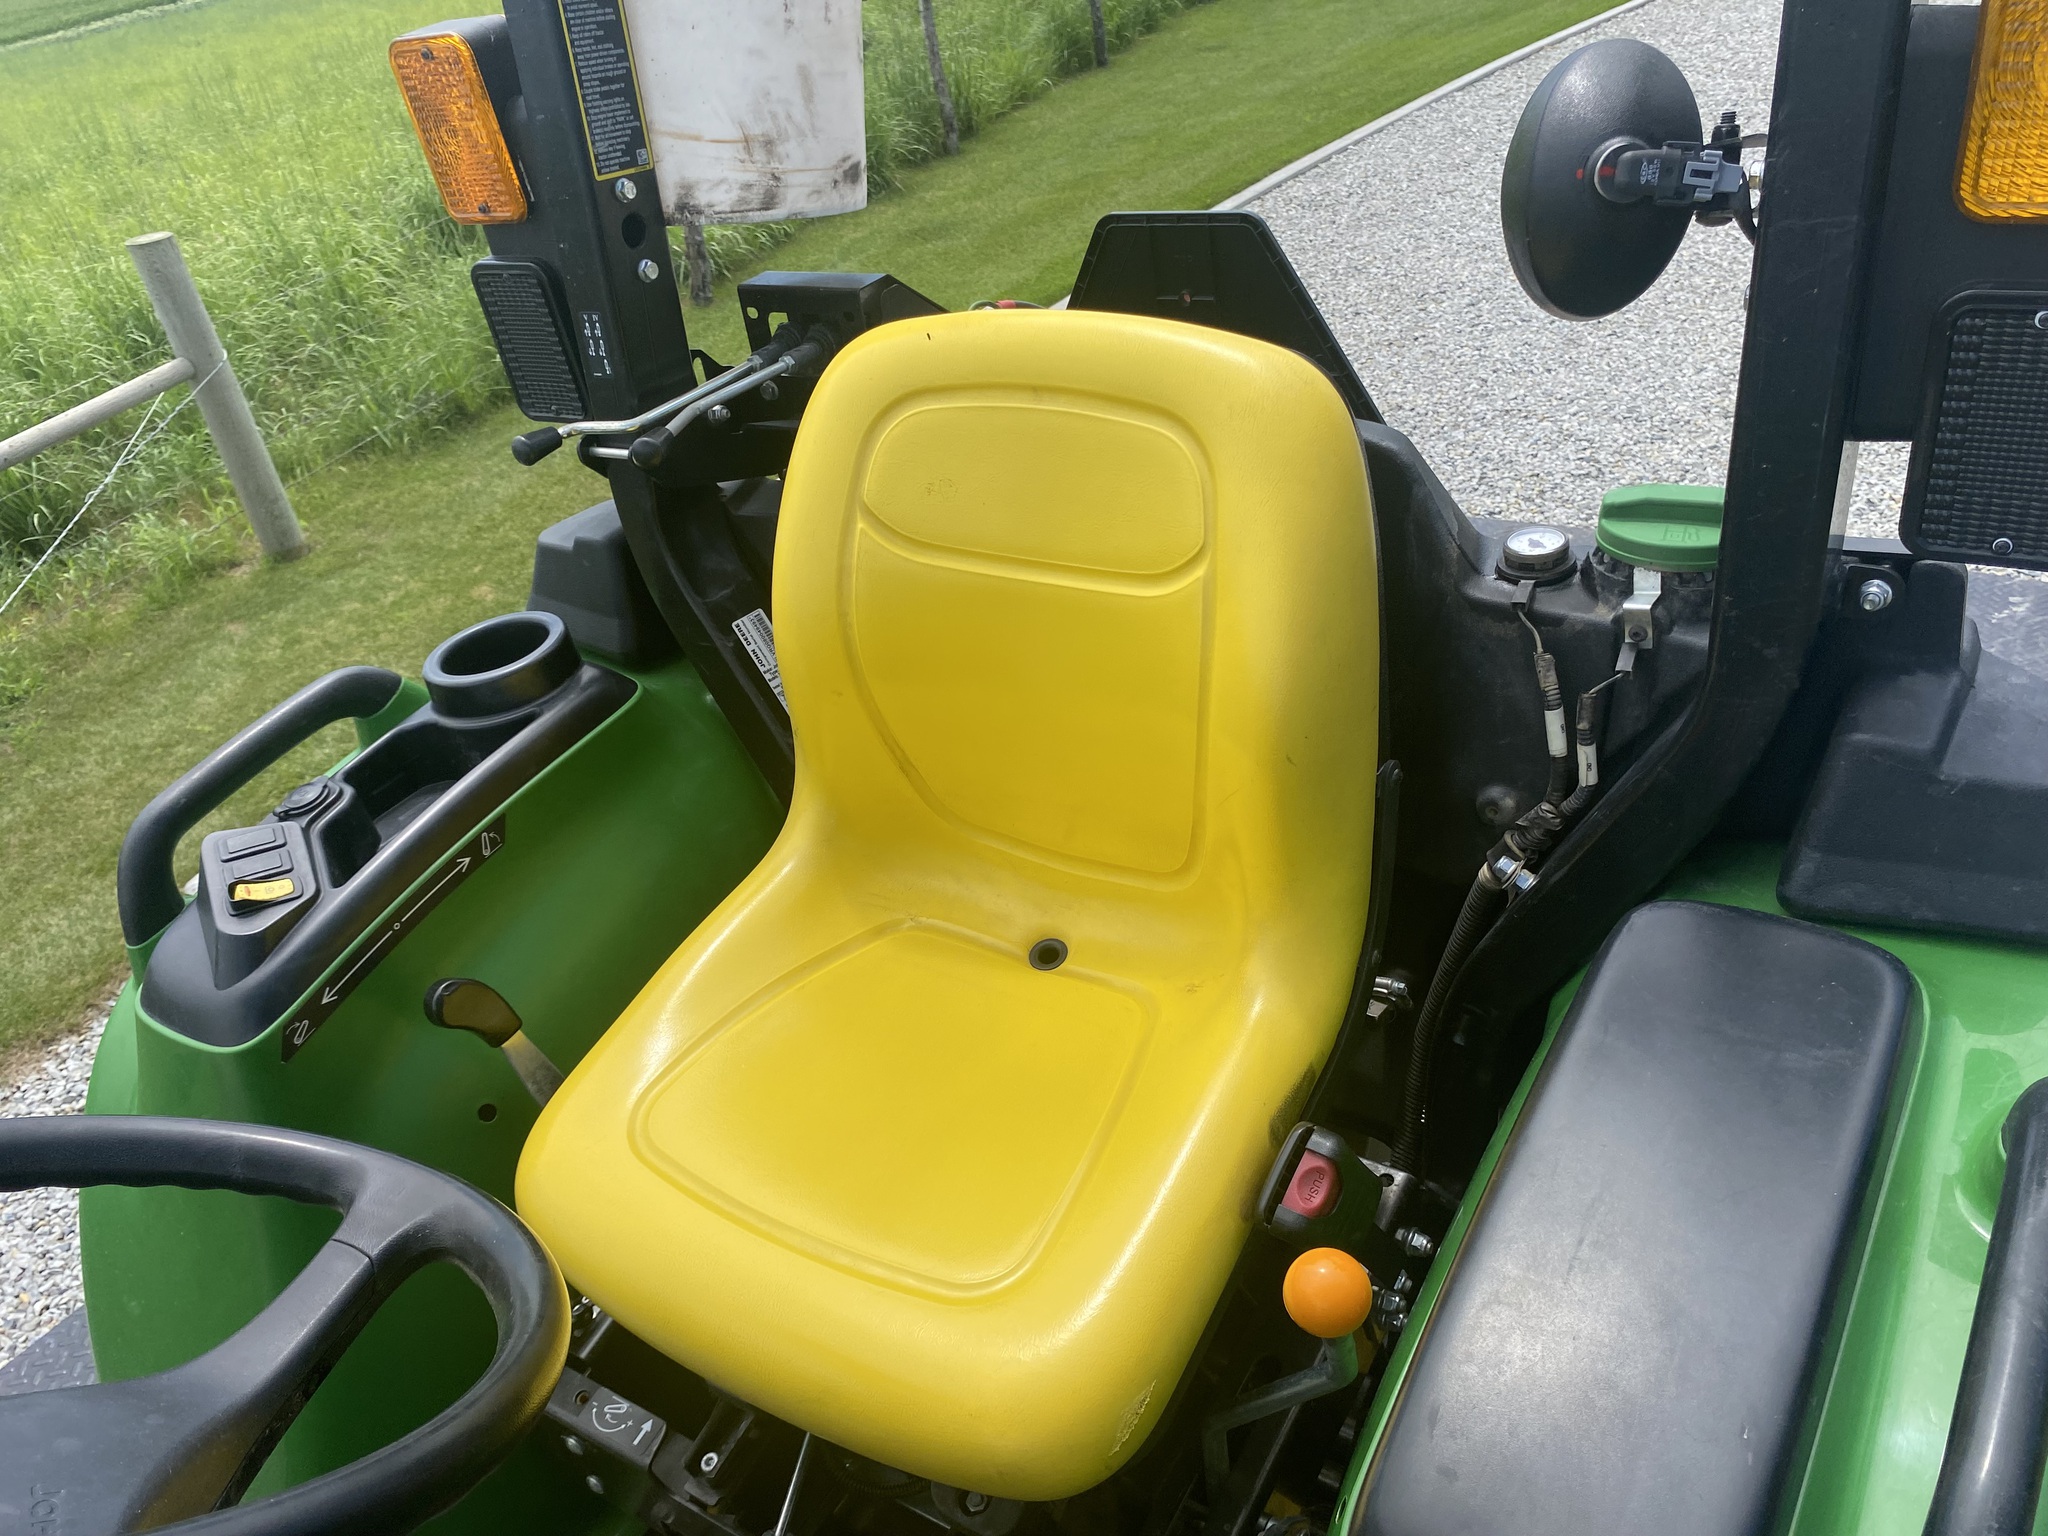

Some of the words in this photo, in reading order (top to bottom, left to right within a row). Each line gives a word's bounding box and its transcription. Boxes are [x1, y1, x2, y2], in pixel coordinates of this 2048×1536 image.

[734, 622, 752, 646] DEERE
[751, 649, 766, 668] JOHN
[1304, 1170, 1325, 1202] PUSH
